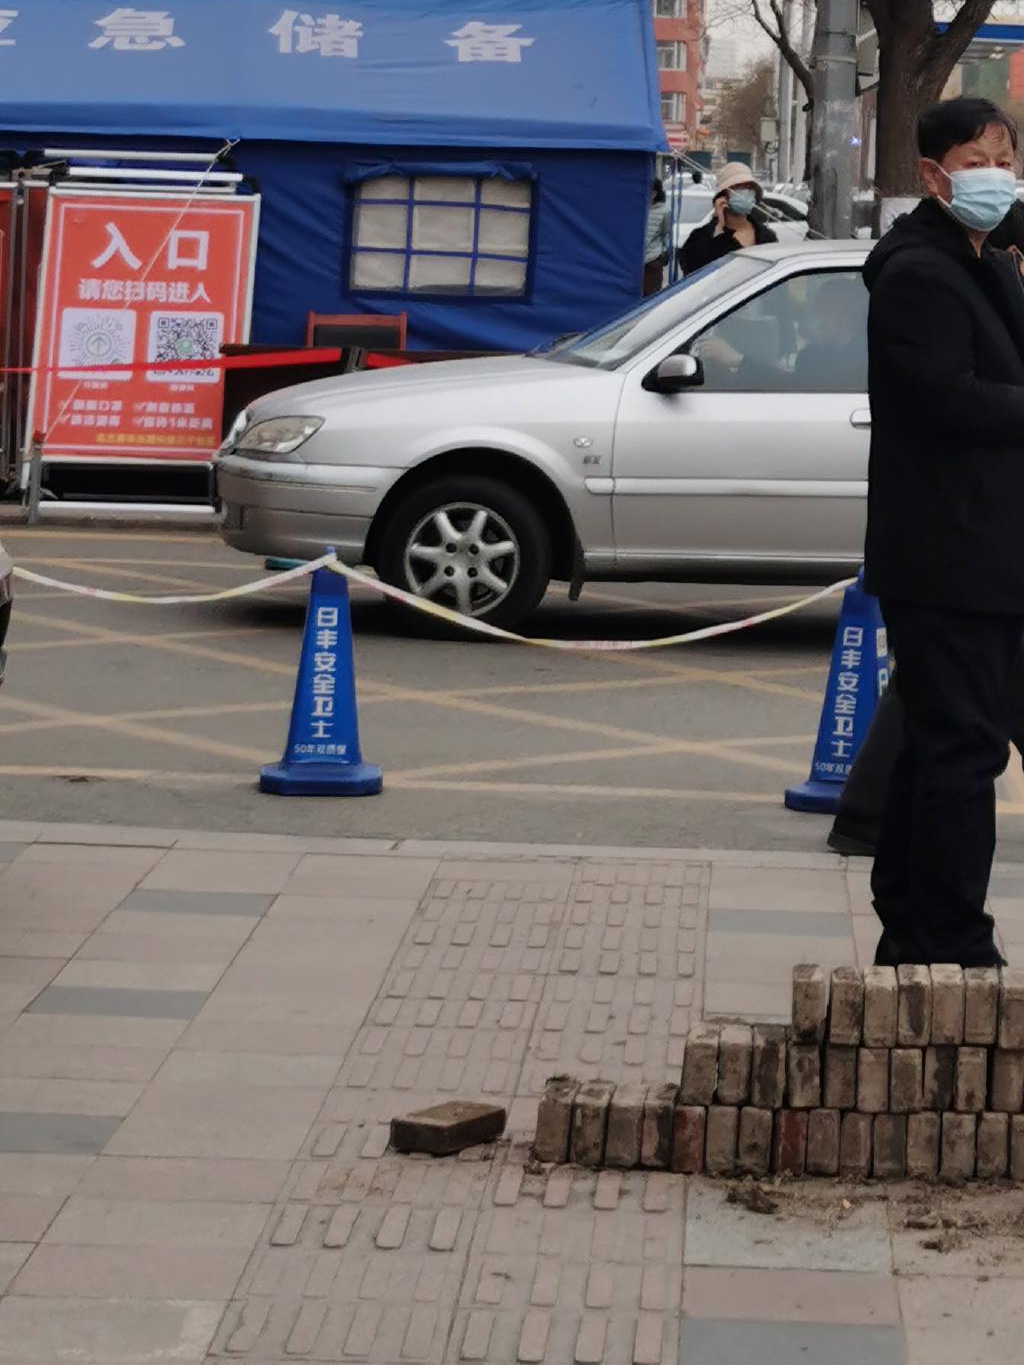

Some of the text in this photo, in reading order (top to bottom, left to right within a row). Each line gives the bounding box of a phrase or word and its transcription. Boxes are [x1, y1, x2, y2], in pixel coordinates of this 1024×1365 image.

[0, 8, 535, 62] 急储备
[91, 221, 210, 271] 入口
[78, 278, 212, 304] 请您扫码进入
[310, 607, 338, 739] 日丰安全卫士
[831, 626, 863, 758] 日丰安全卫士
